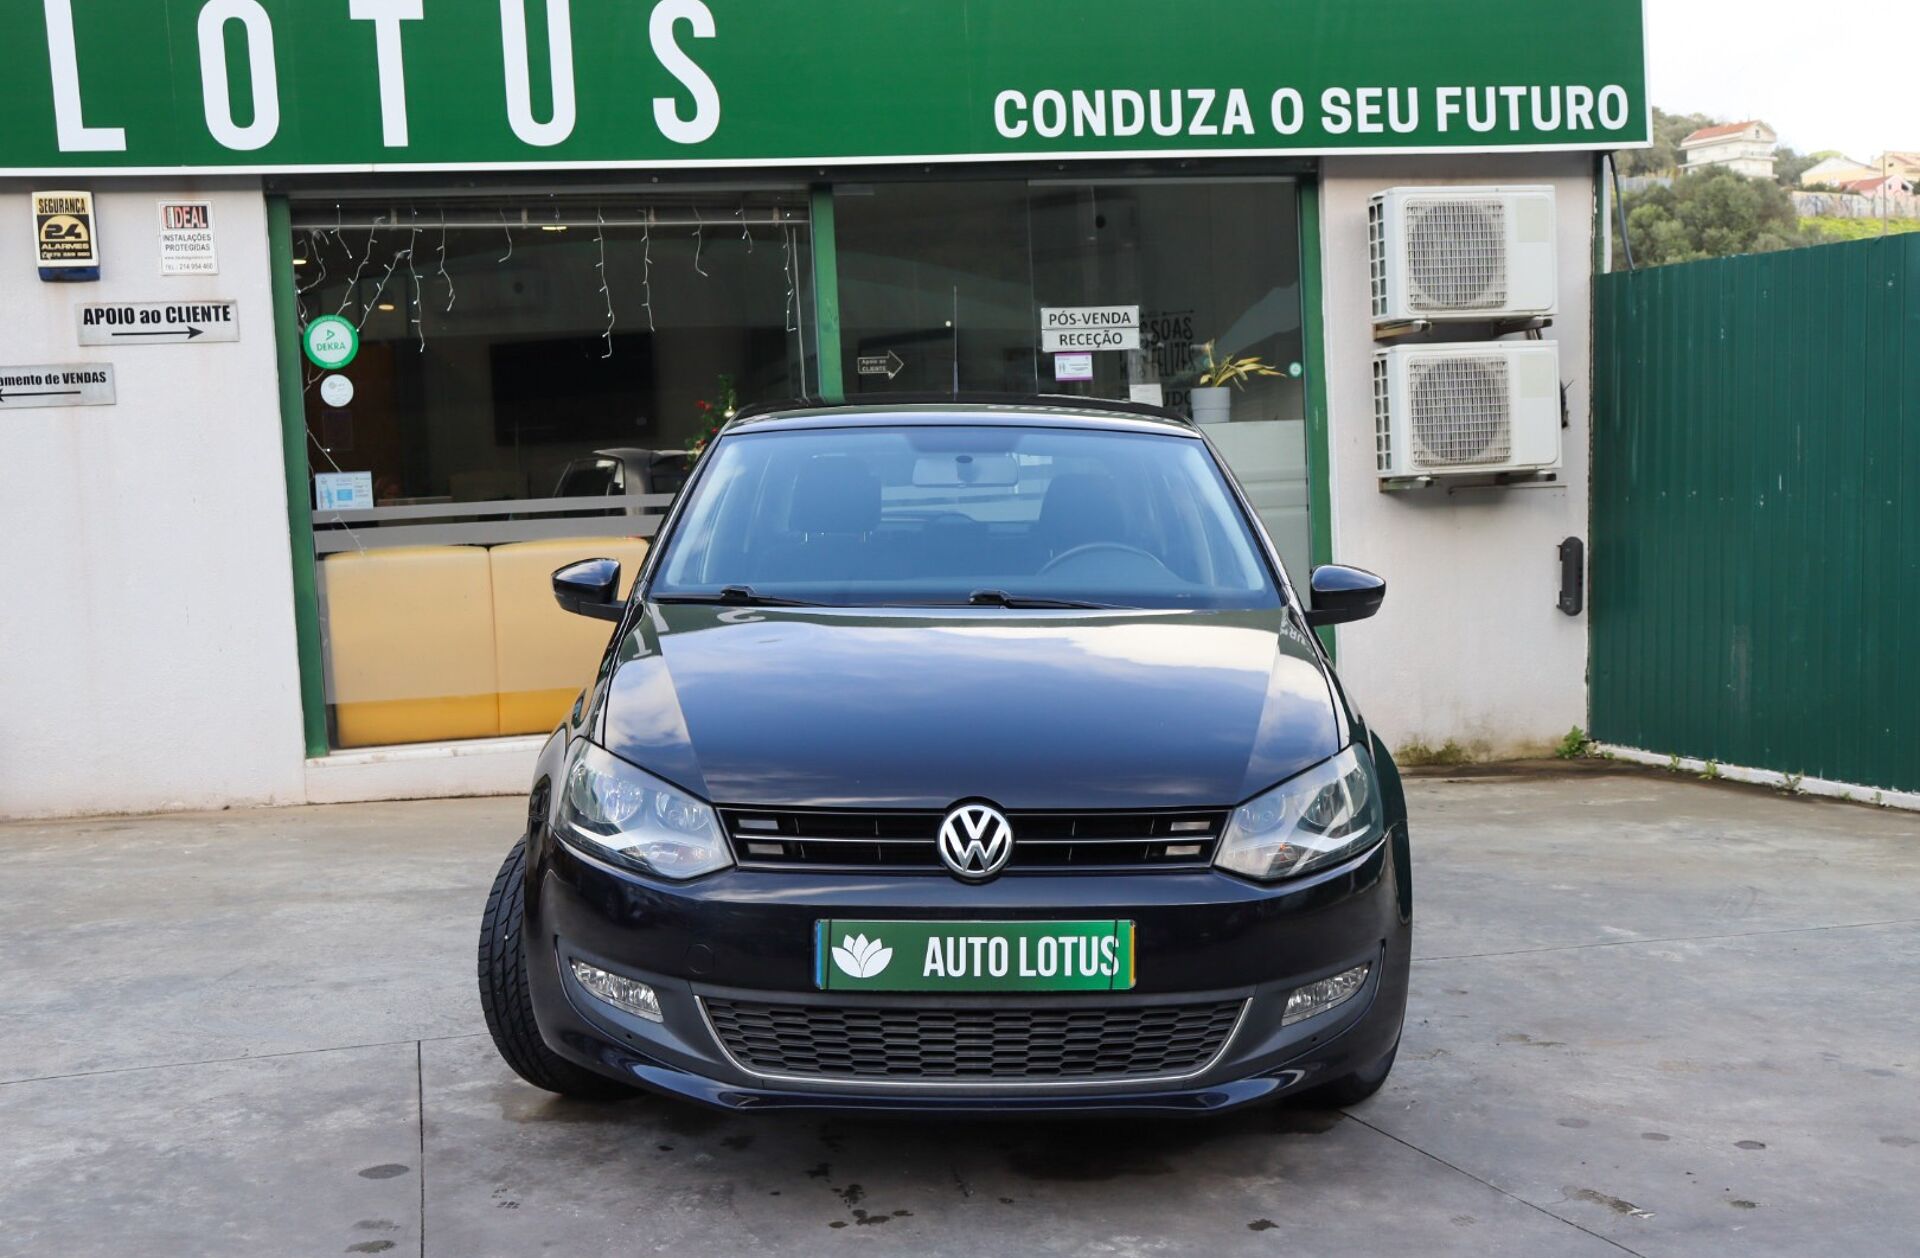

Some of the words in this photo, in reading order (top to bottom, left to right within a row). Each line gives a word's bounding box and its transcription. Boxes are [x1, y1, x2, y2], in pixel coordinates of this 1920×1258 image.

[45, 0, 721, 152] LOTUS
[994, 89, 1255, 138] CONDUZA
[1270, 87, 1304, 135] O
[1320, 86, 1419, 134] SEU
[1436, 84, 1629, 132] FUTURO
[45, 223, 82, 240] 24
[163, 233, 212, 242] INSTALAÇÕES
[165, 244, 211, 252] PROTEGIDAS
[83, 308, 135, 325] APOIO
[140, 310, 161, 324] ao
[166, 305, 231, 323] CLIENTE
[1049, 310, 1131, 326] PÓS-VENDA
[316, 342, 346, 351] DEKRA
[1060, 330, 1123, 348] RECEÇÃO
[45, 374, 60, 385] de
[62, 372, 107, 384] VENDAS
[923, 937, 1008, 977] AUTO
[1019, 936, 1119, 976] LOTUS
